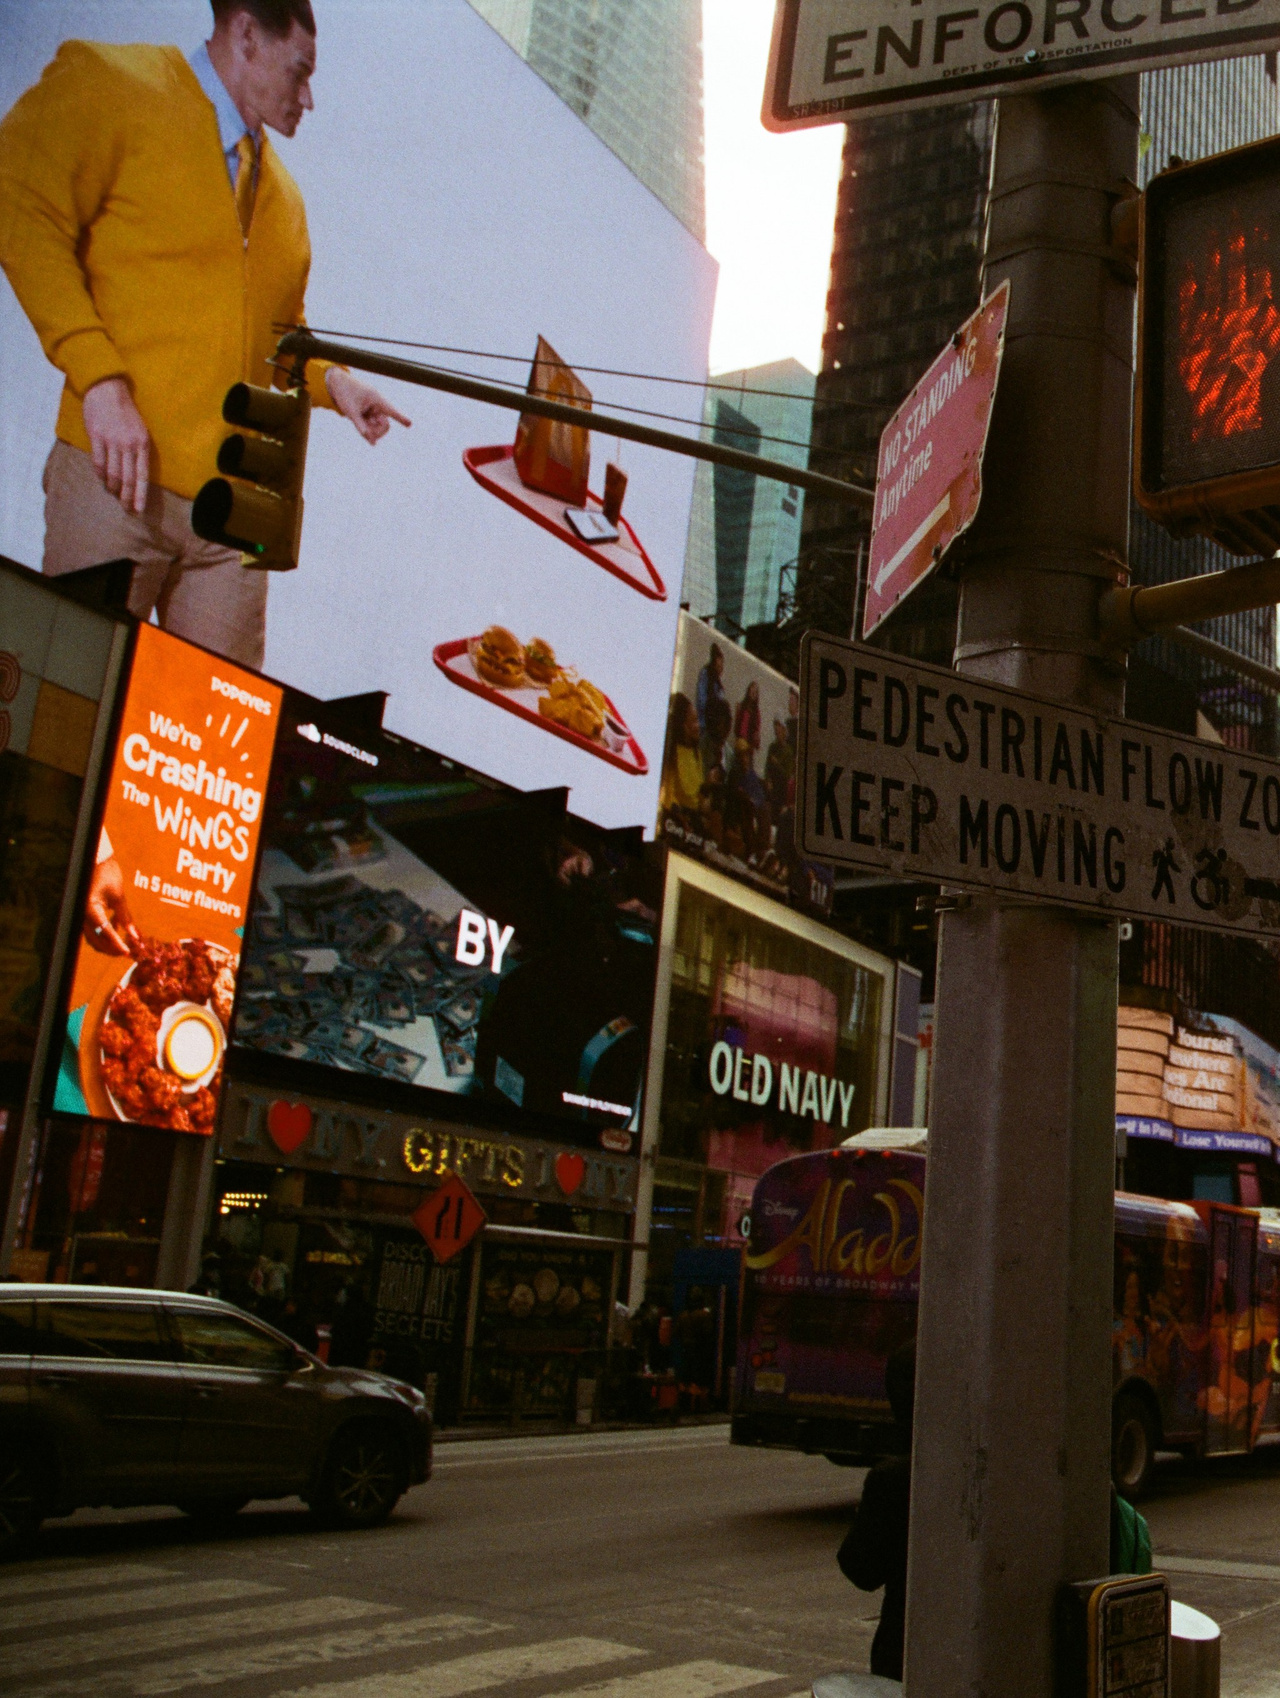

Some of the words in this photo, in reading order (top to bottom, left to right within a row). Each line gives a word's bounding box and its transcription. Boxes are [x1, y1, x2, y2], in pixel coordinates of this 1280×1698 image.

[943, 64, 977, 78] DEPT
[983, 59, 1001, 70] OF
[1007, 37, 1133, 65] TRSPORTATION
[882, 431, 901, 479] NO
[903, 336, 977, 453] STANDING
[879, 440, 933, 527] Anytime
[150, 710, 203, 751] We're
[818, 658, 1105, 797] PEDESTRIAN
[1120, 738, 1223, 823] FLOW
[121, 780, 151, 807] The
[122, 733, 262, 823] Crashing
[815, 762, 939, 855] KEEP
[959, 794, 1125, 893] MOVING
[150, 875, 161, 892] 5
[161, 881, 194, 903] new
[194, 889, 241, 919] flavors
[176, 847, 236, 894] Party
[456, 908, 515, 974] BY
[709, 1040, 773, 1106] OLD
[779, 1062, 855, 1128] NAVY
[307, 1108, 389, 1167] NY
[403, 1127, 526, 1187] GIFTS
[745, 1178, 924, 1277] Aladd
[773, 1275, 810, 1287] YEARS
[815, 1277, 830, 1287] OF
[836, 1278, 906, 1291] BROADWAY
